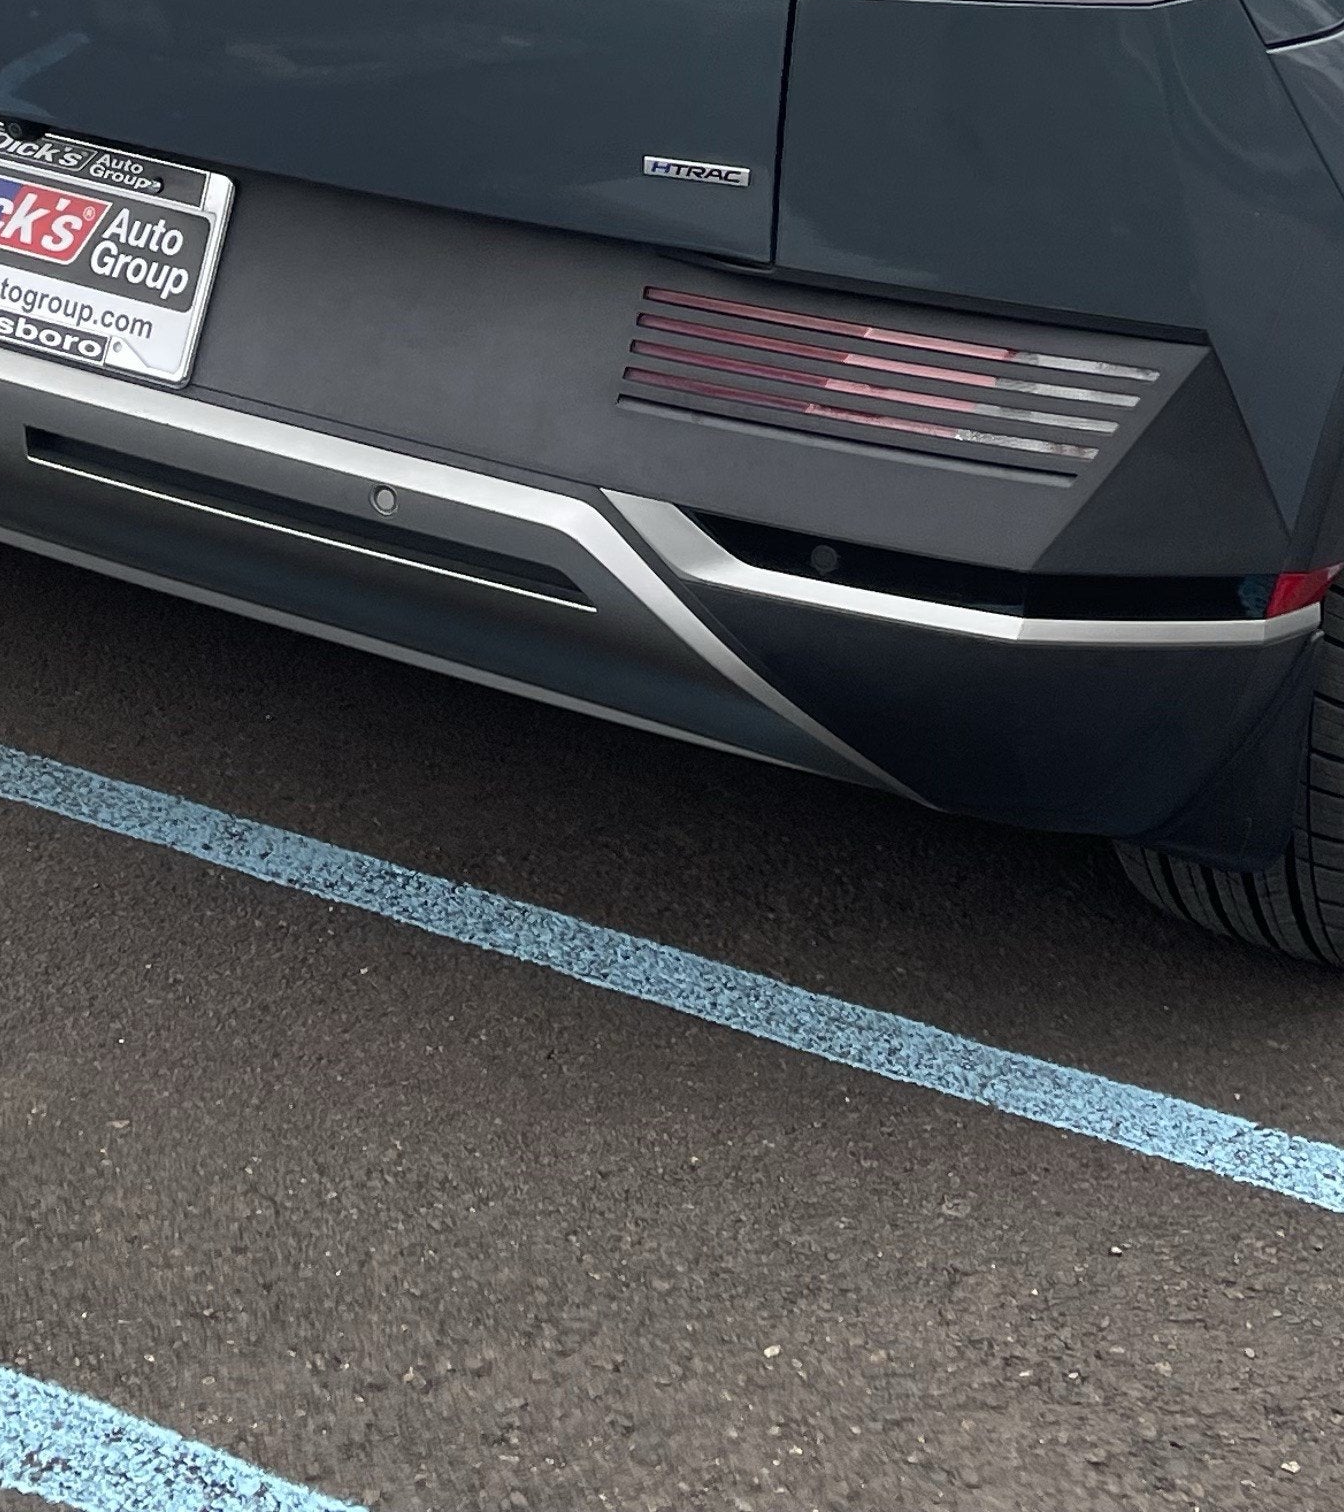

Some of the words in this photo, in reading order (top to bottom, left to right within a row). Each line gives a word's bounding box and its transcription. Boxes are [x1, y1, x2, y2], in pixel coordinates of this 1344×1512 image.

[97, 153, 144, 174] Auto
[651, 161, 742, 184] HTRAC
[89, 165, 153, 190] Group
[101, 207, 184, 256] Auto
[90, 242, 189, 301] Group
